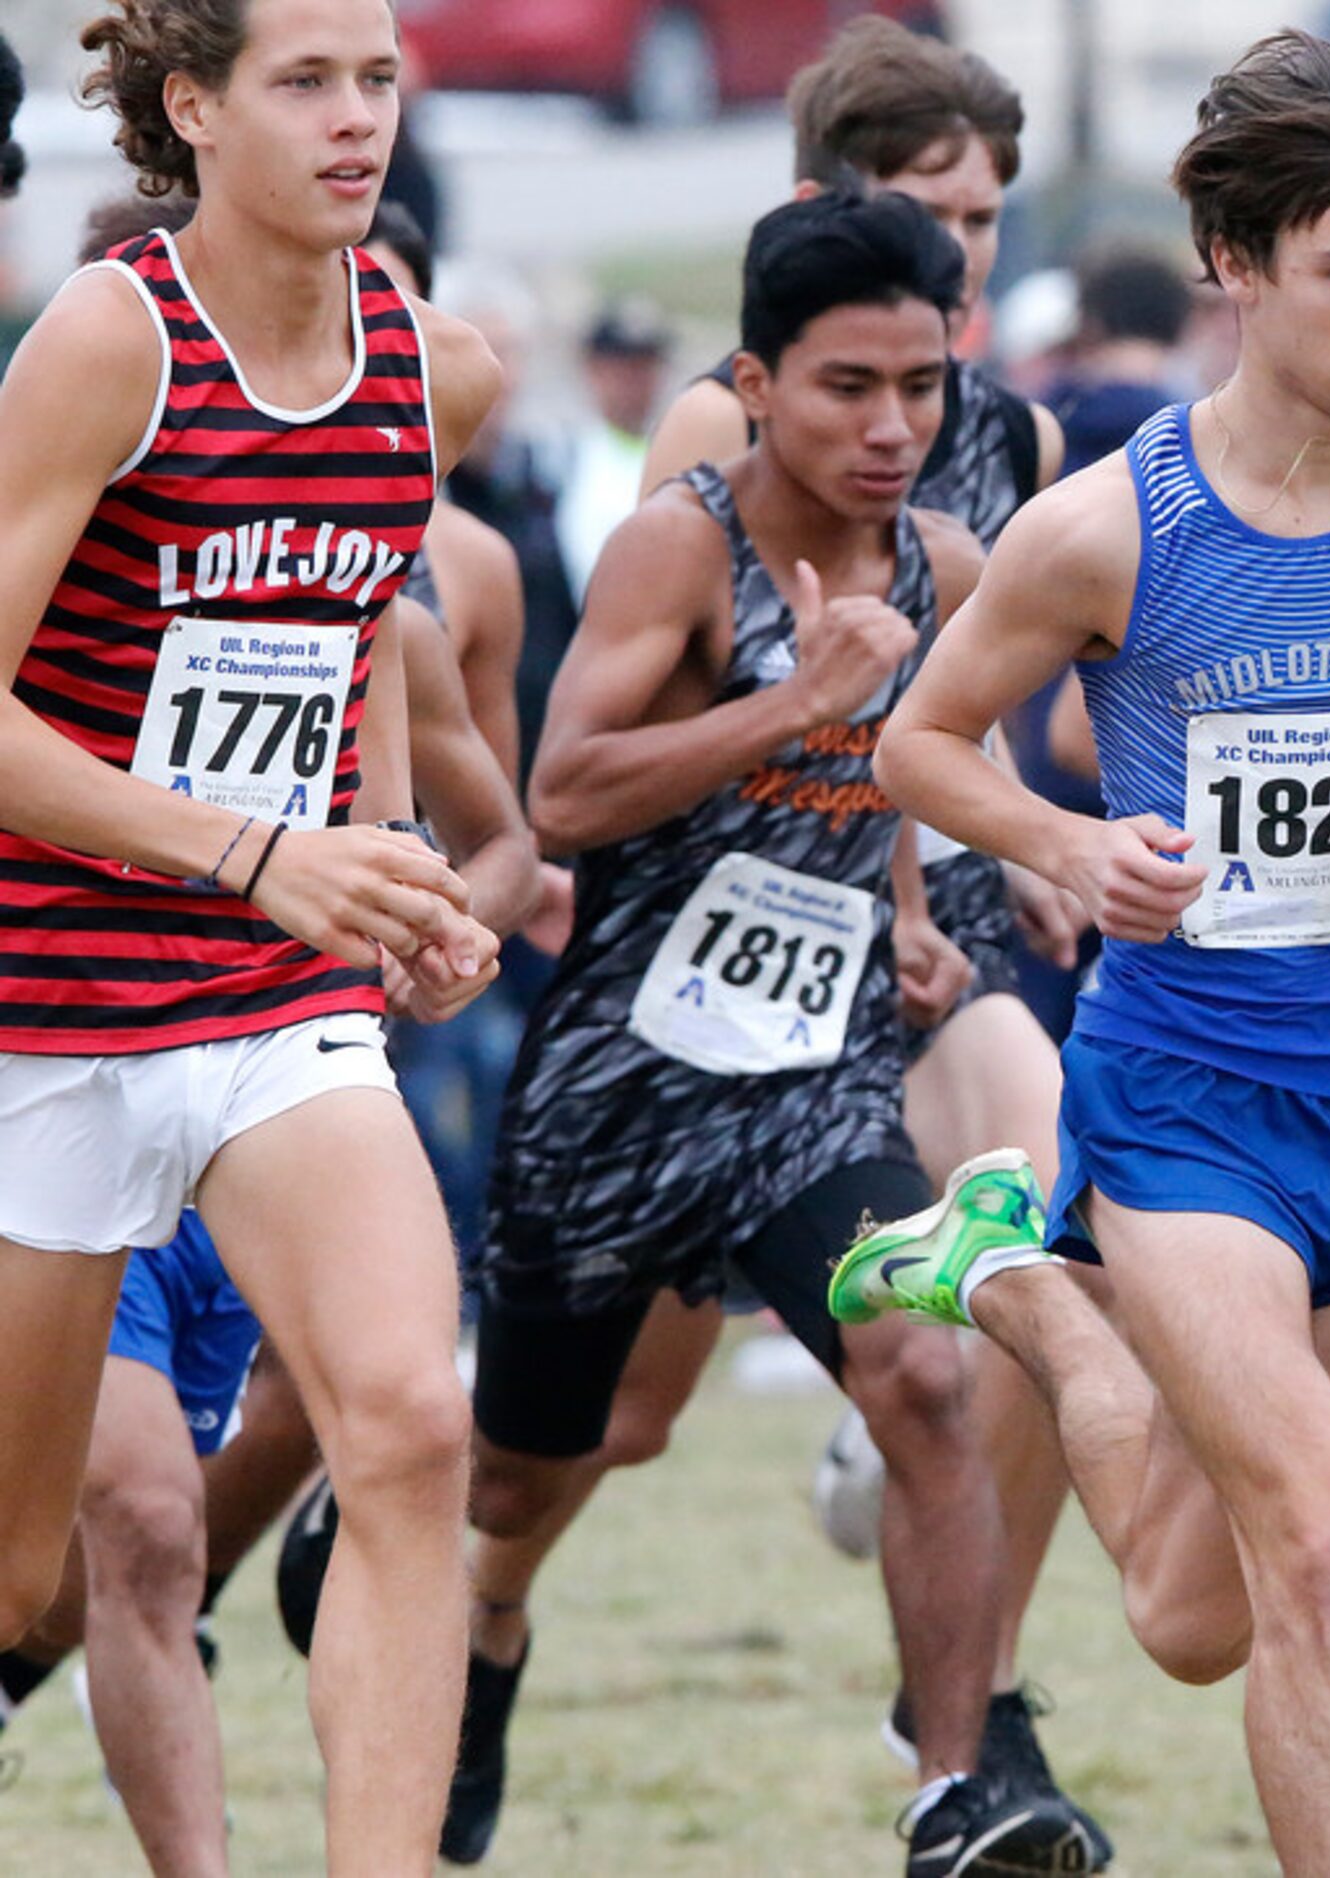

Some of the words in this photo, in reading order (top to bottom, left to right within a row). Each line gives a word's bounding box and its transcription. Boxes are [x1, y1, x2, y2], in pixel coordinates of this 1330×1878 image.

[158, 518, 405, 608] LOVEJOY
[220, 637, 245, 653] UIL
[249, 638, 305, 658] Region
[308, 641, 320, 655] II
[186, 655, 210, 672] XC
[215, 658, 339, 681] Championships
[168, 686, 336, 778] 1776
[1247, 728, 1279, 744] UIL
[1214, 745, 1243, 762] XC
[689, 909, 847, 1017] 1813
